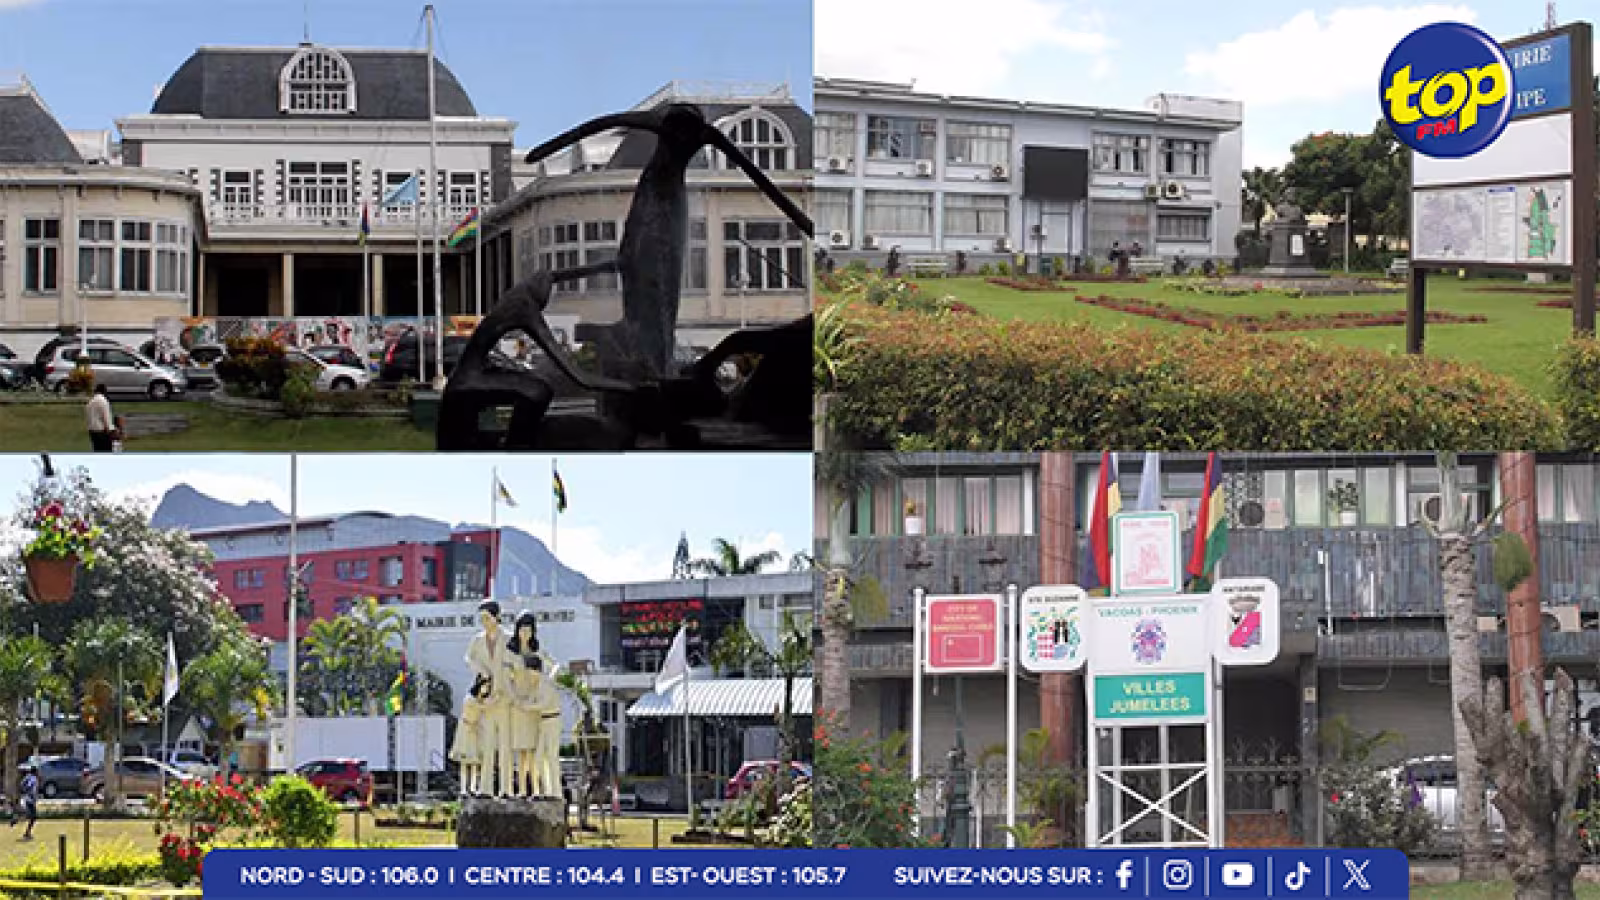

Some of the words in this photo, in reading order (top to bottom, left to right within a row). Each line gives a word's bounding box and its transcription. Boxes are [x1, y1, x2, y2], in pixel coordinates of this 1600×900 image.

[1513, 45, 1552, 69] IRIE
[1517, 88, 1547, 110] IPE
[1099, 607, 1142, 618] VACOAS
[1151, 606, 1198, 616] PHOENIX
[417, 616, 456, 628] MAIRIE
[460, 615, 474, 628] DE
[1122, 679, 1177, 696] VILLES
[1110, 696, 1191, 714] JUMELEES
